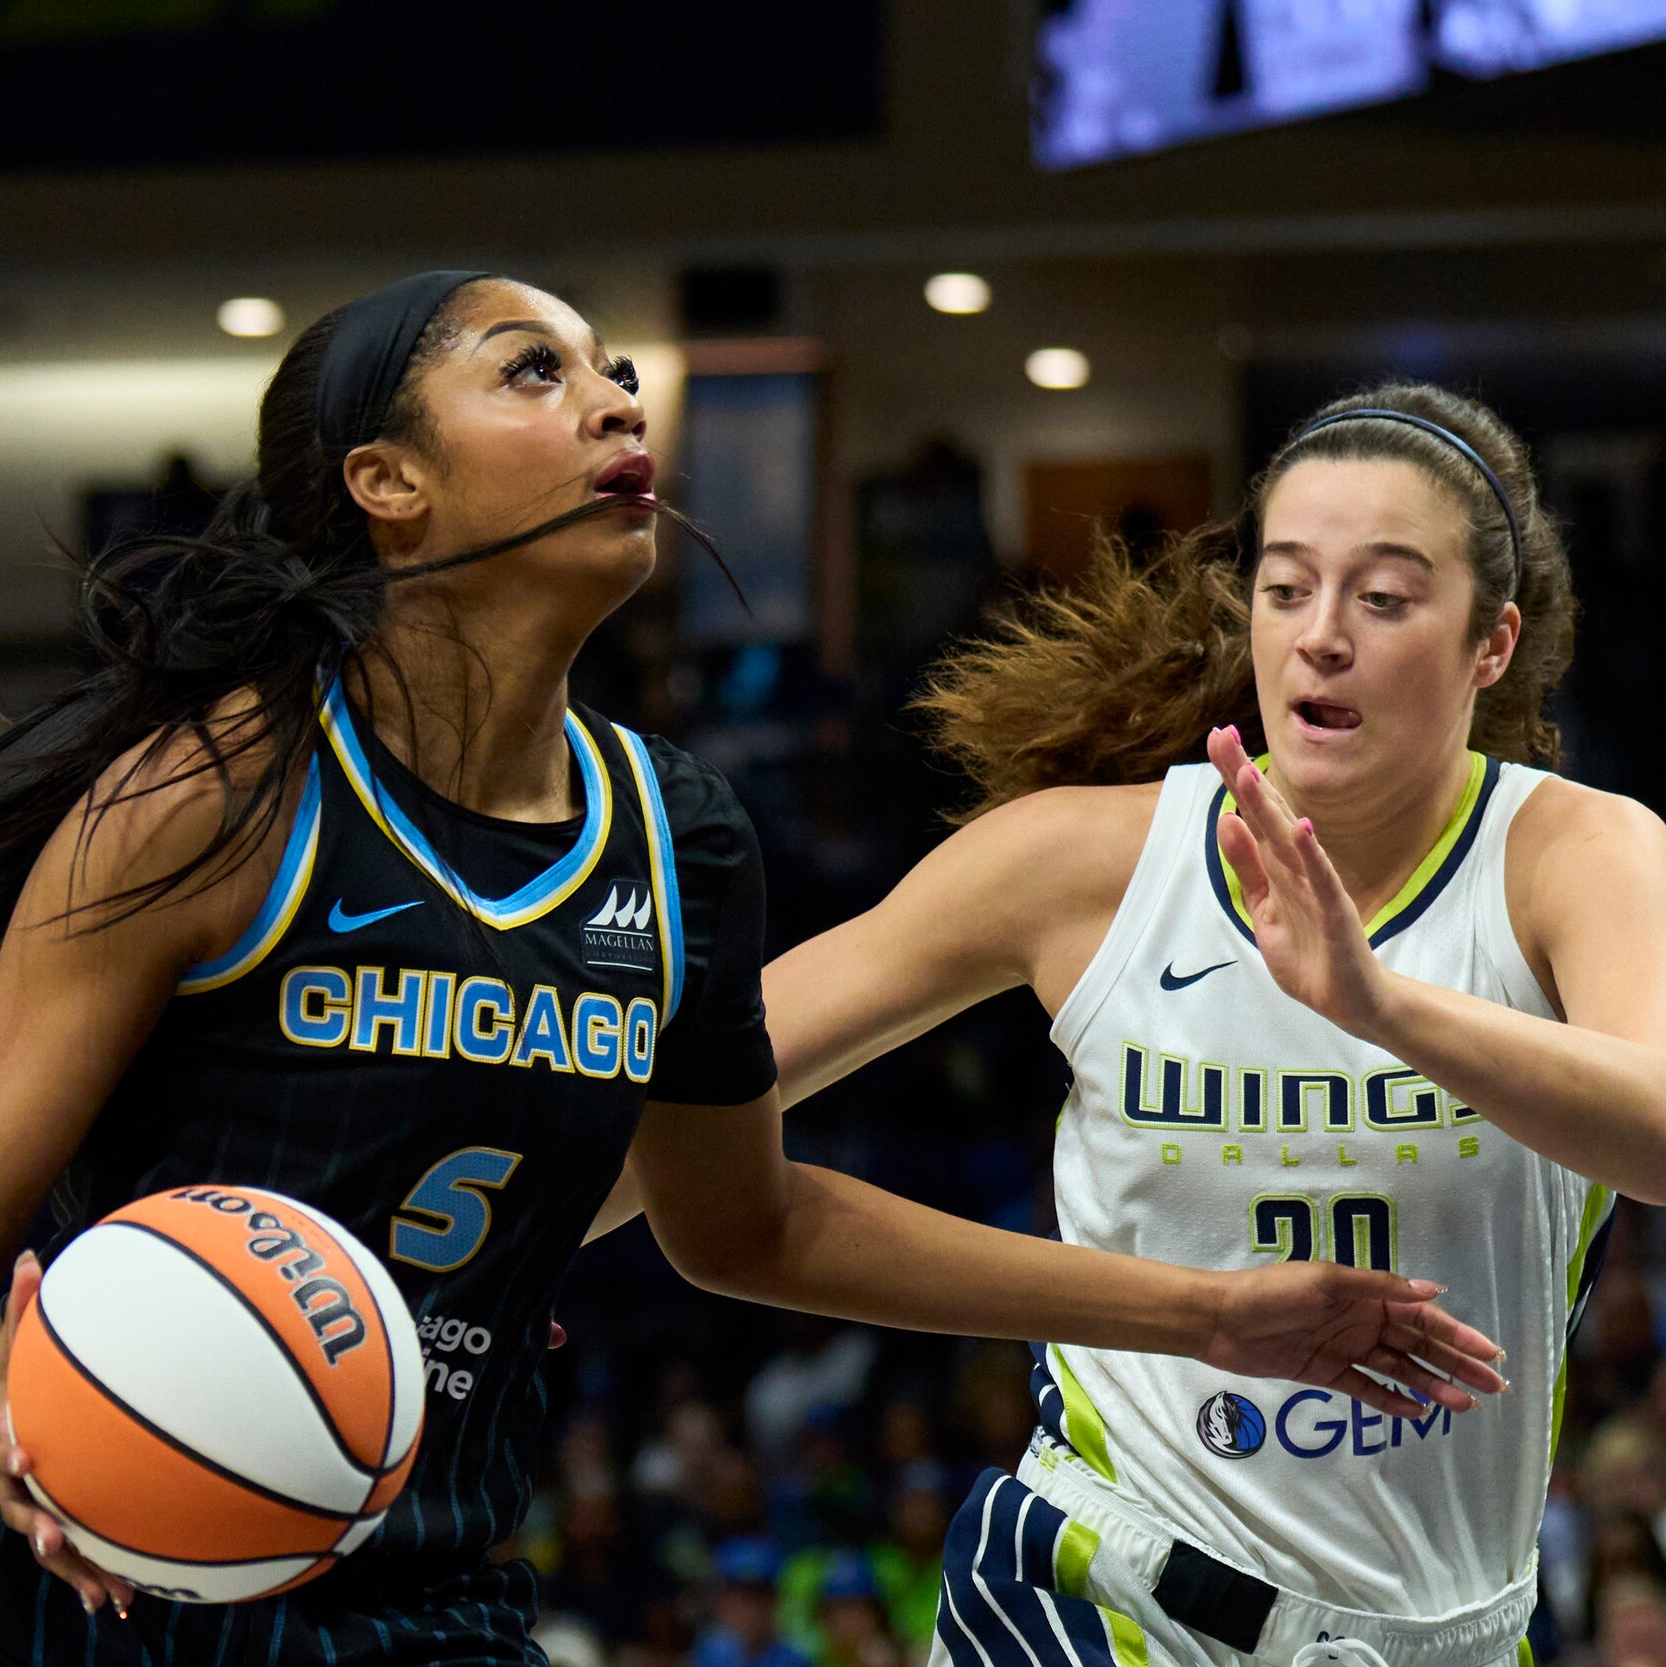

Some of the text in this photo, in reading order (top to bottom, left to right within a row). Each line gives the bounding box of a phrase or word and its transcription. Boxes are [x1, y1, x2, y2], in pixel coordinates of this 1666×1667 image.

[584, 932, 654, 952] MAGELLAN
[279, 965, 658, 1085] CHICAGO
[388, 1145, 525, 1274] 5
[1162, 1136, 1480, 1166] DALLAS
[169, 1188, 366, 1368] Wilson
